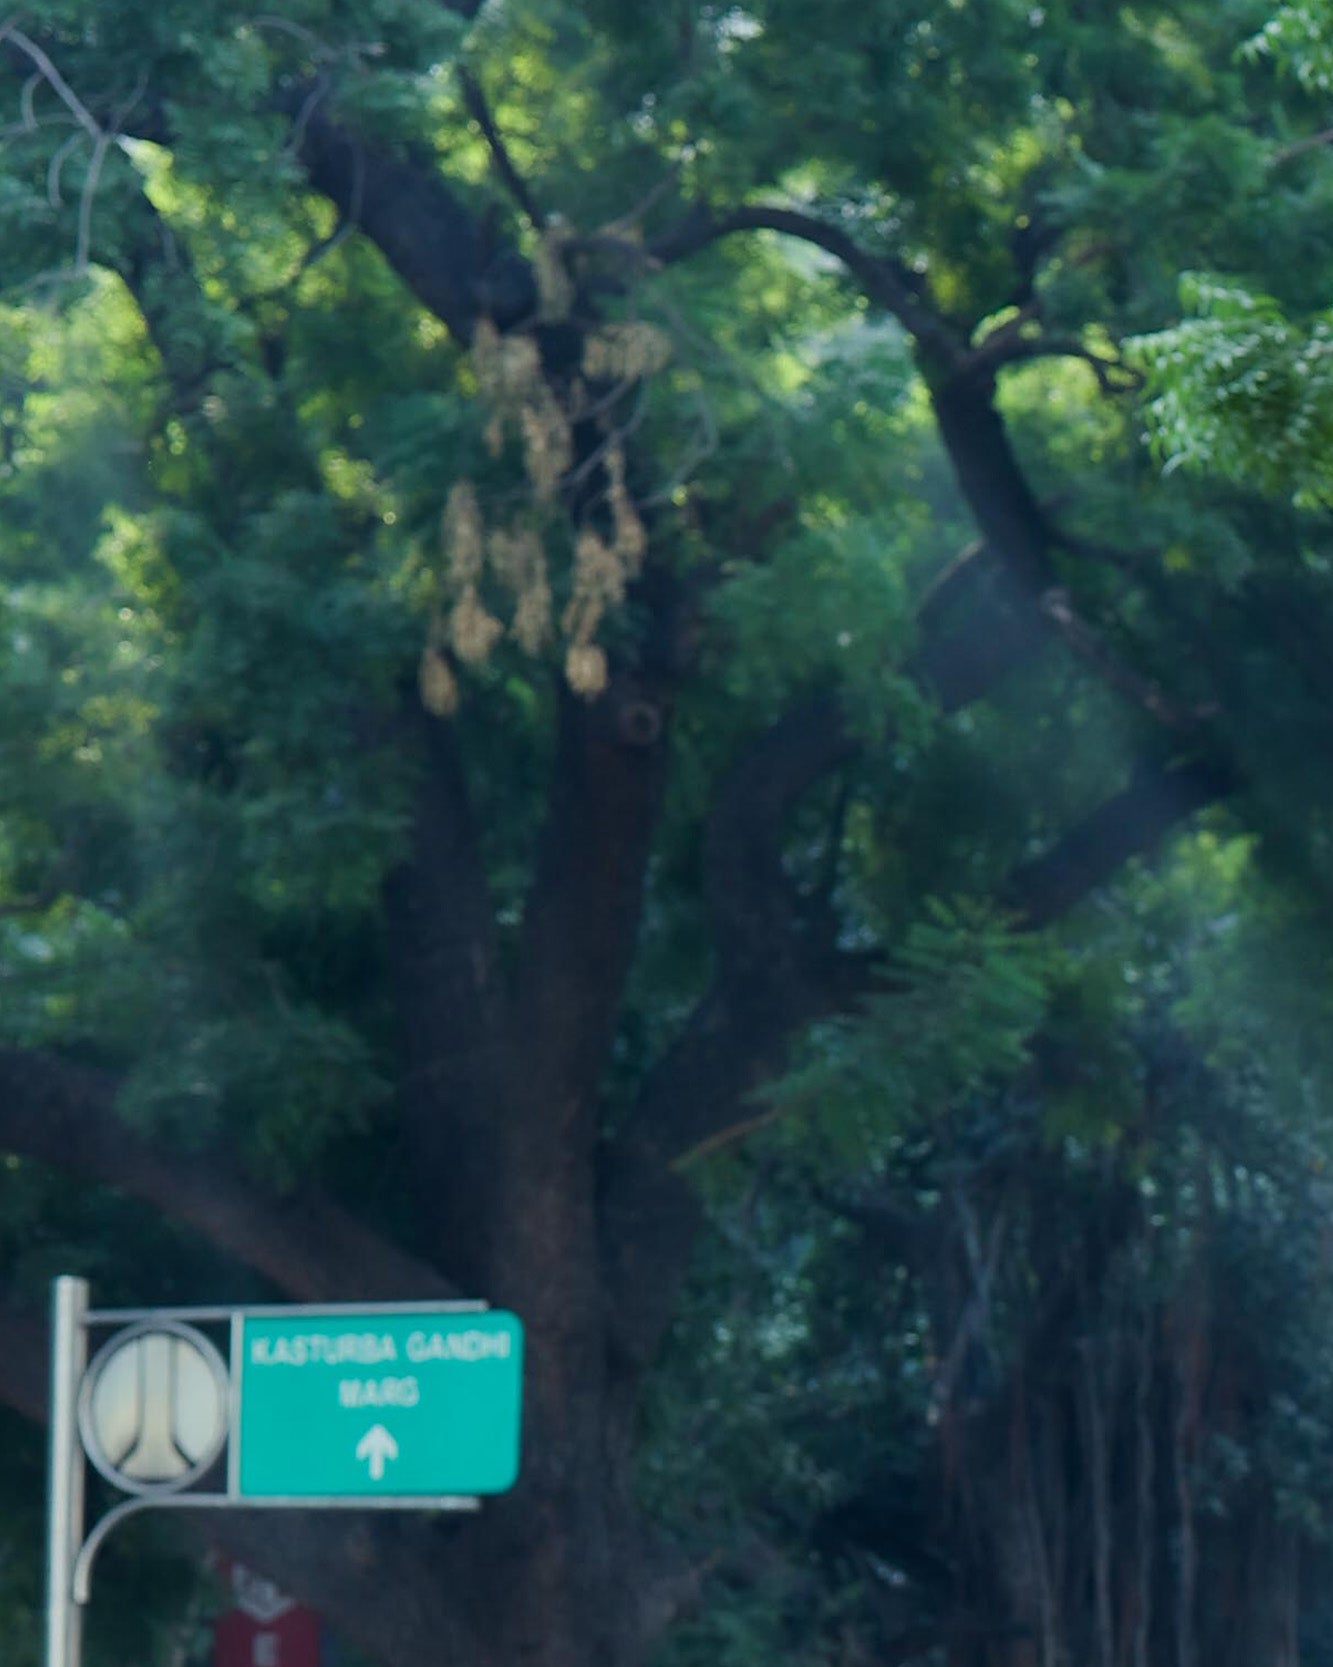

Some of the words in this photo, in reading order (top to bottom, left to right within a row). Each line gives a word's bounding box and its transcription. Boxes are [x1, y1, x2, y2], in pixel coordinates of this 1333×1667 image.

[251, 1334, 398, 1366] KASTURBA
[406, 1330, 511, 1363] GANDHI
[339, 1376, 420, 1408] MARG
